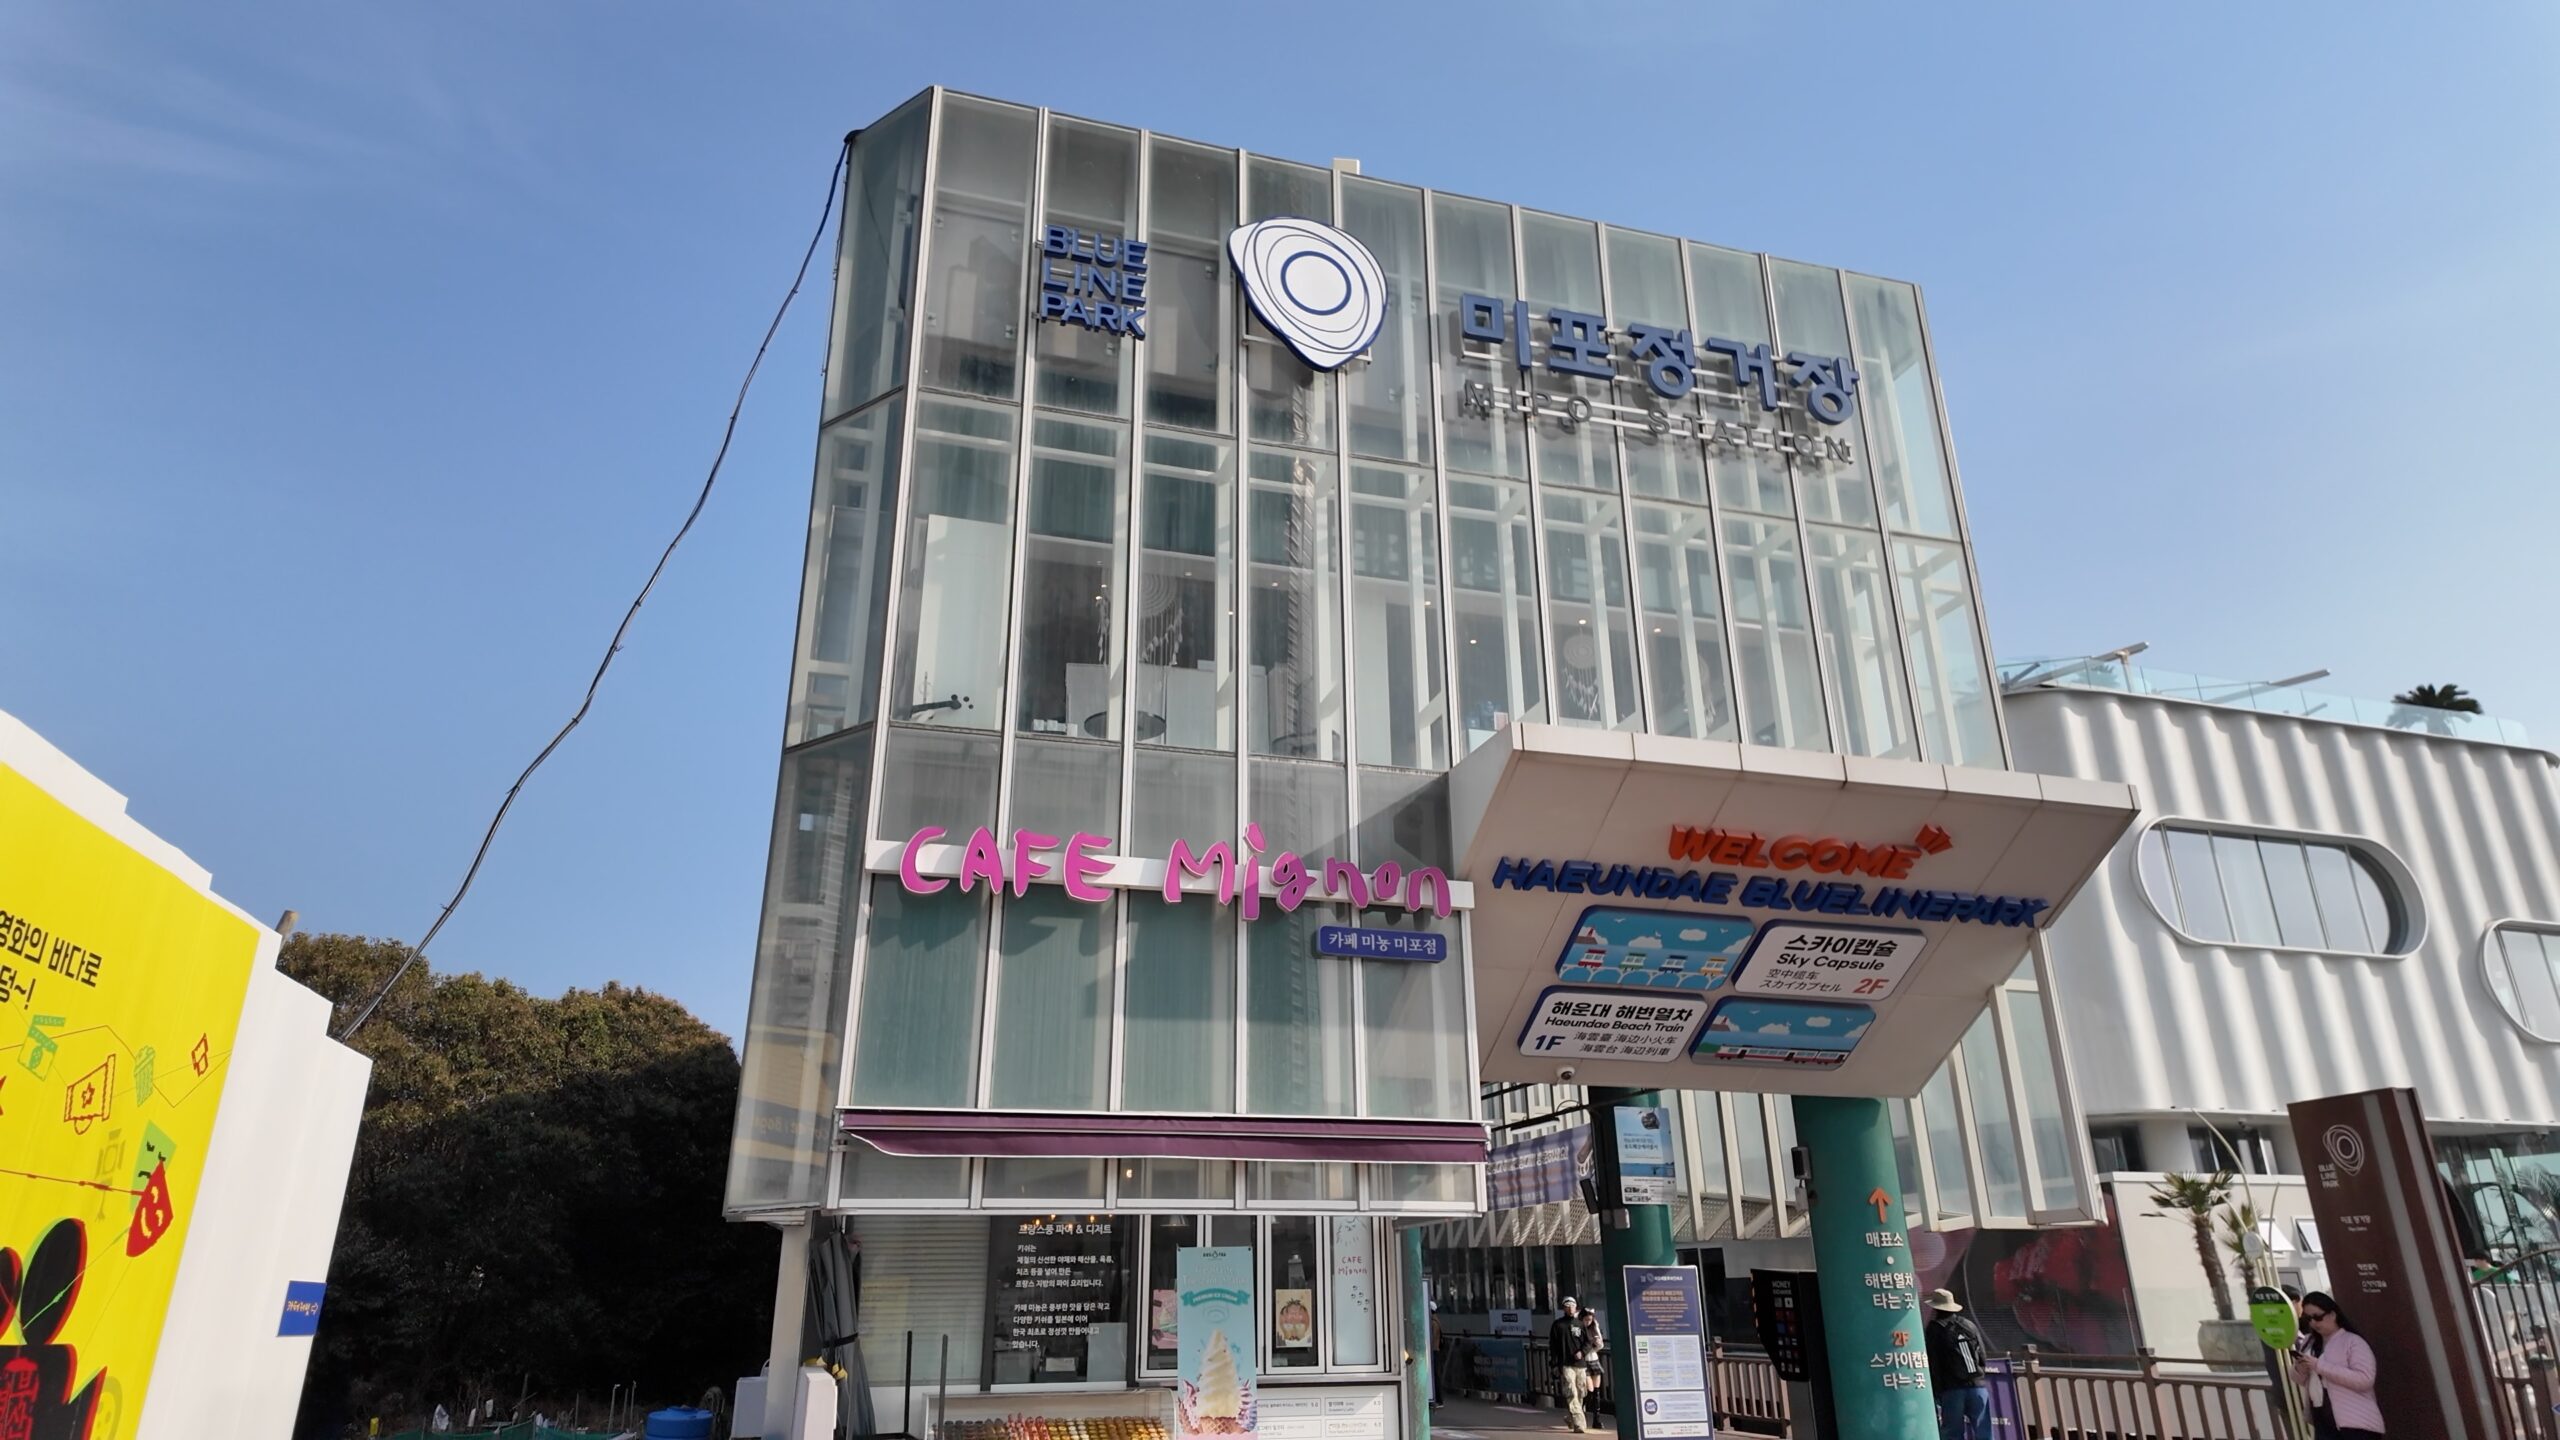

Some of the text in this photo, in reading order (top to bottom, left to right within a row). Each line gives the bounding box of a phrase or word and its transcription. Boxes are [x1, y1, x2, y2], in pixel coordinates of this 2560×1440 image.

[1044, 225, 1148, 274] BLUE
[1043, 258, 1147, 307] LINE
[1040, 292, 1146, 340] PARK
[1464, 379, 1854, 464] MIPO STATION
[1668, 824, 1922, 880] WELCOME
[900, 822, 1452, 921] CAFE Mignon
[1492, 856, 2049, 928] HAEUNDAE BLUELINEPARK
[1329, 931, 1358, 950] 카페
[1394, 936, 1437, 955] 미포점
[1784, 934, 1898, 958] 스카이캡슐
[47, 937, 103, 989] 바다로
[1776, 953, 1886, 971] Sky Capsule
[1853, 978, 1890, 995] 2F
[1551, 1001, 1694, 1022] 해운대 해변열차
[1545, 1016, 1685, 1033] Haeundae Beach Train
[1534, 1034, 1566, 1051] 1F
[1018, 1223, 1113, 1235] 프랑스풍 파이 & 디저트
[1865, 1232, 1904, 1248] 매표소
[1037, 1256, 1056, 1264] 신선한
[1341, 1256, 1363, 1264] CAFE
[1015, 1280, 1034, 1288] 프랑스
[1056, 1279, 1069, 1287] 파이
[1070, 1279, 1104, 1287] 요리입니다.
[1864, 1272, 1914, 1289] 해변열차
[1014, 1303, 1027, 1312] 카페
[1872, 1292, 1915, 1310] 타는 곳
[1013, 1316, 1033, 1324] 다양한
[1074, 1315, 1088, 1323] 이어
[1012, 1328, 1026, 1336] 한국
[1893, 1331, 1909, 1346] 2F
[1914, 1372, 1926, 1389] 곳
